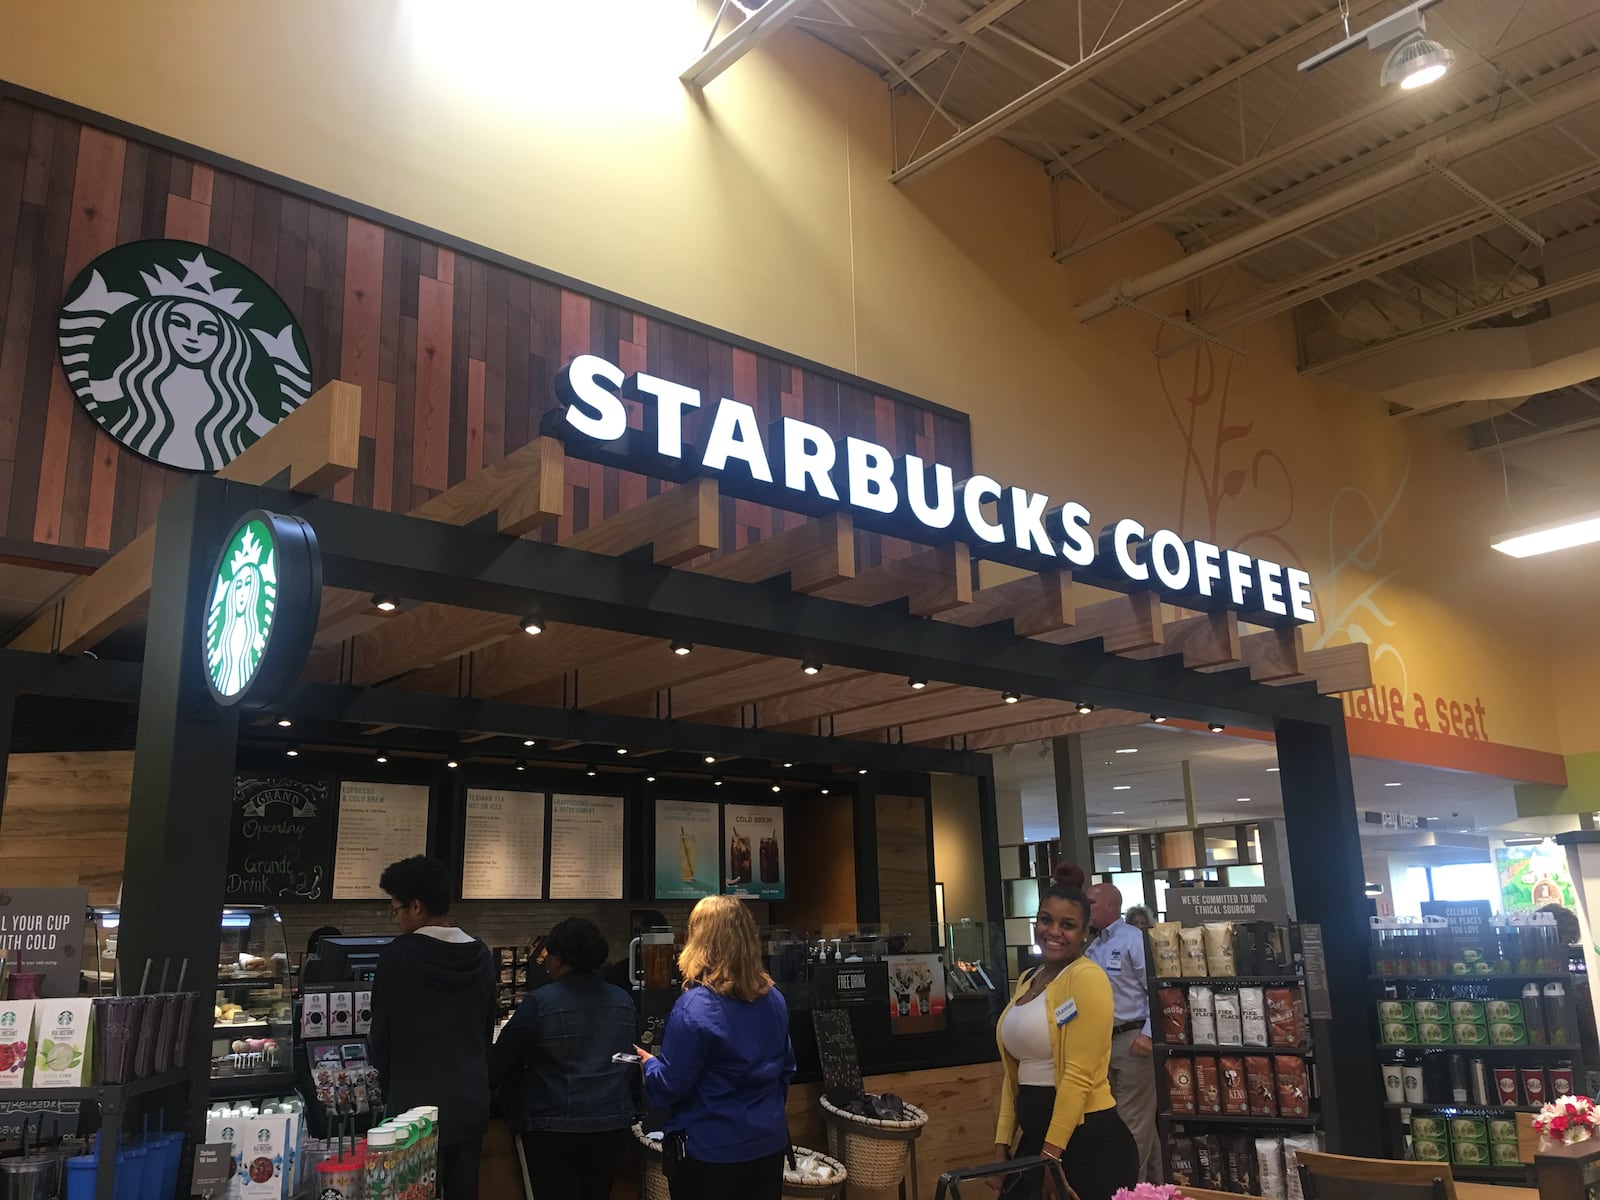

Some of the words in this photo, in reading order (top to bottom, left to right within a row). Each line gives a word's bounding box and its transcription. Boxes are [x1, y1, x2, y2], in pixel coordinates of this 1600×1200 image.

[565, 353, 1095, 566] STARBUCKS
[1114, 518, 1316, 623] COFFEE
[1414, 693, 1431, 731] a
[1436, 697, 1489, 742] seat
[342, 786, 375, 795] ESPRESSO
[349, 795, 366, 803] COLD
[494, 795, 505, 803] TEA
[468, 802, 479, 810] HOT
[559, 807, 595, 815] REFRESHMENT
[736, 816, 753, 824] COLD
[1381, 811, 1398, 829] pay
[1400, 812, 1419, 829] here
[242, 820, 306, 841] Opening
[244, 855, 293, 875] Grande
[226, 873, 272, 894] Drink
[1181, 895, 1200, 905] WE'RE
[1202, 894, 1239, 905] COMMITTED
[1239, 894, 1249, 903] TO
[1250, 894, 1268, 904] 100%
[1195, 904, 1221, 915] ETHICAL
[1223, 904, 1256, 914] SOURCING
[1446, 908, 1479, 917] CELEBRATE
[12, 915, 43, 931] YOUR
[47, 914, 71, 931] CUP
[1459, 917, 1482, 926] PLACES
[1450, 926, 1462, 934] YOU
[1465, 926, 1479, 934] LOVE
[26, 934, 57, 951] COLD
[837, 974, 850, 989] FREE
[850, 974, 866, 989] DRINK
